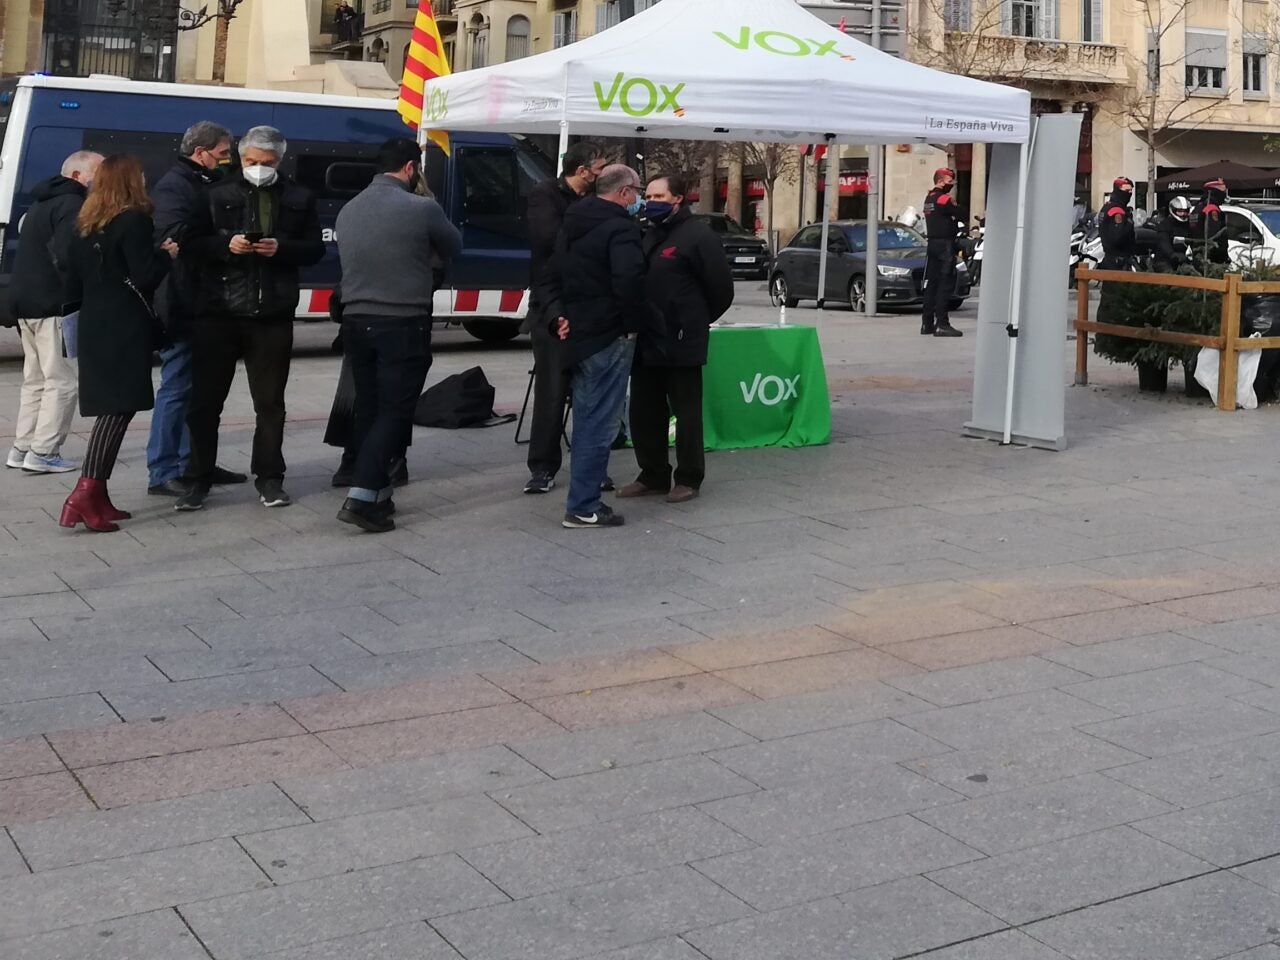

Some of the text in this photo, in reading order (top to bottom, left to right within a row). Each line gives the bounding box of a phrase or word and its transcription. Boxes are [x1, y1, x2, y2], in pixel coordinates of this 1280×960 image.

[712, 26, 844, 57] VOX
[593, 72, 686, 117] VOX
[929, 117, 1014, 132] La España Viva
[740, 373, 800, 405] VOX
